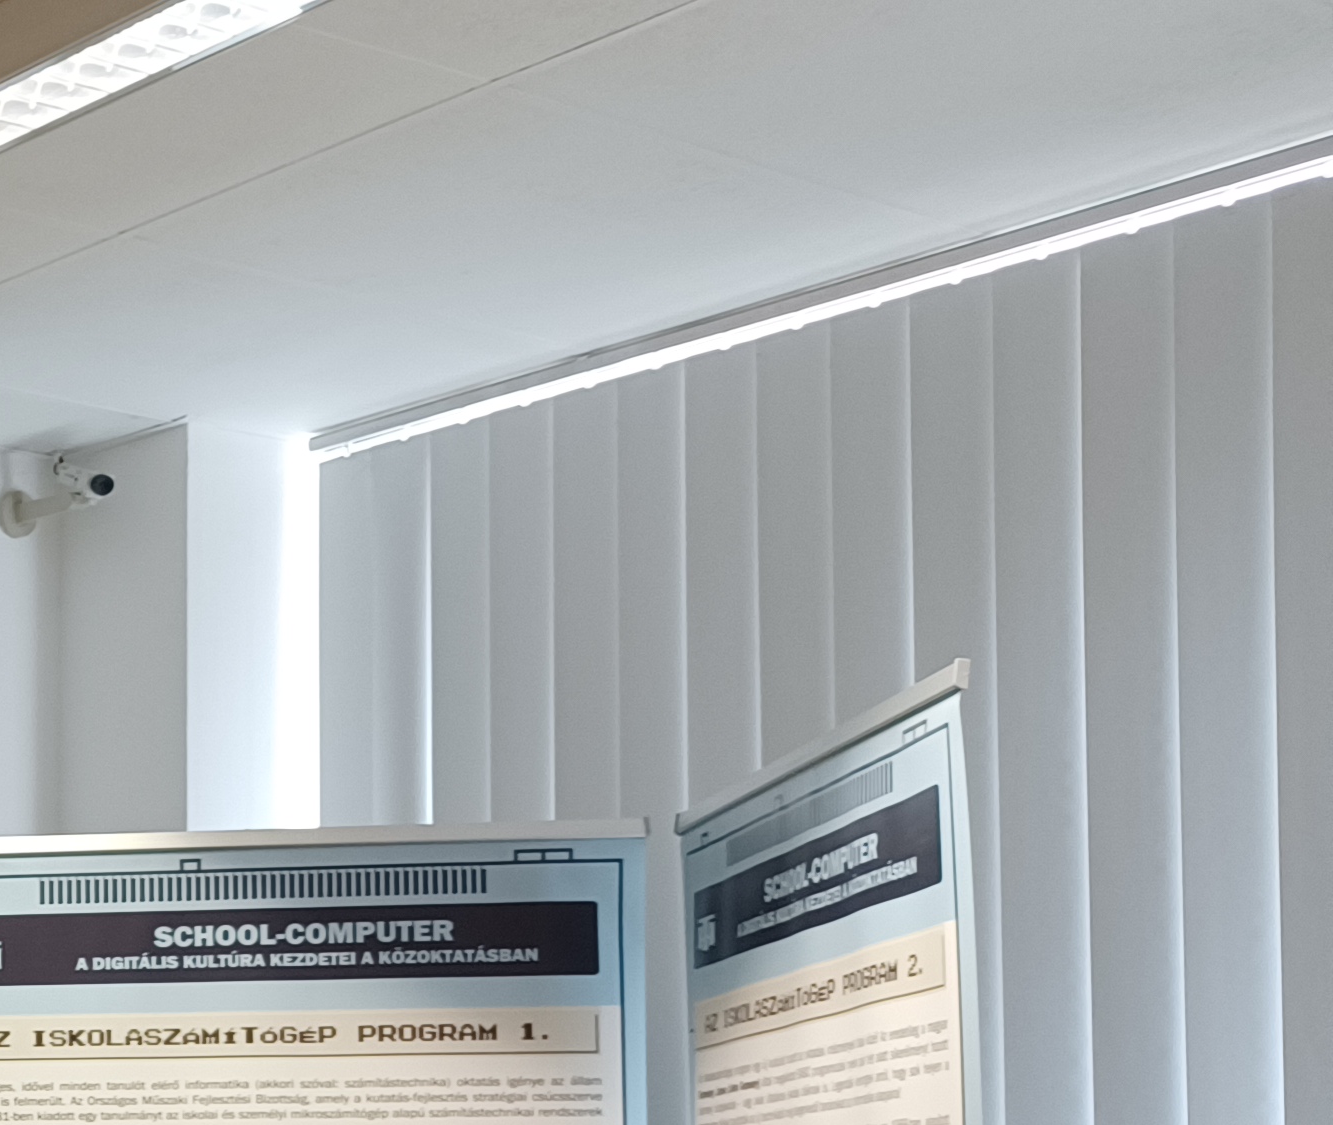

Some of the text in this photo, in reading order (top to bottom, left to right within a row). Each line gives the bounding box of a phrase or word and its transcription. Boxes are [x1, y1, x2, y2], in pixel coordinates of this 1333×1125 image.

[153, 919, 454, 949] SCHOOL-COMPUTER
[75, 945, 539, 971] A DIGITÁLIS KULTÚRA KEZDETEI A KÖZOKTATÁSBAN
[907, 953, 923, 978] 2.
[357, 1023, 498, 1043] PROGRAM
[520, 1022, 550, 1041] 1.
[550, 1077, 564, 1085] az
[0, 1097, 9, 1106] is
[70, 1096, 82, 1105] Az
[78, 1112, 96, 1122] egy
[221, 1109, 235, 1119] és
